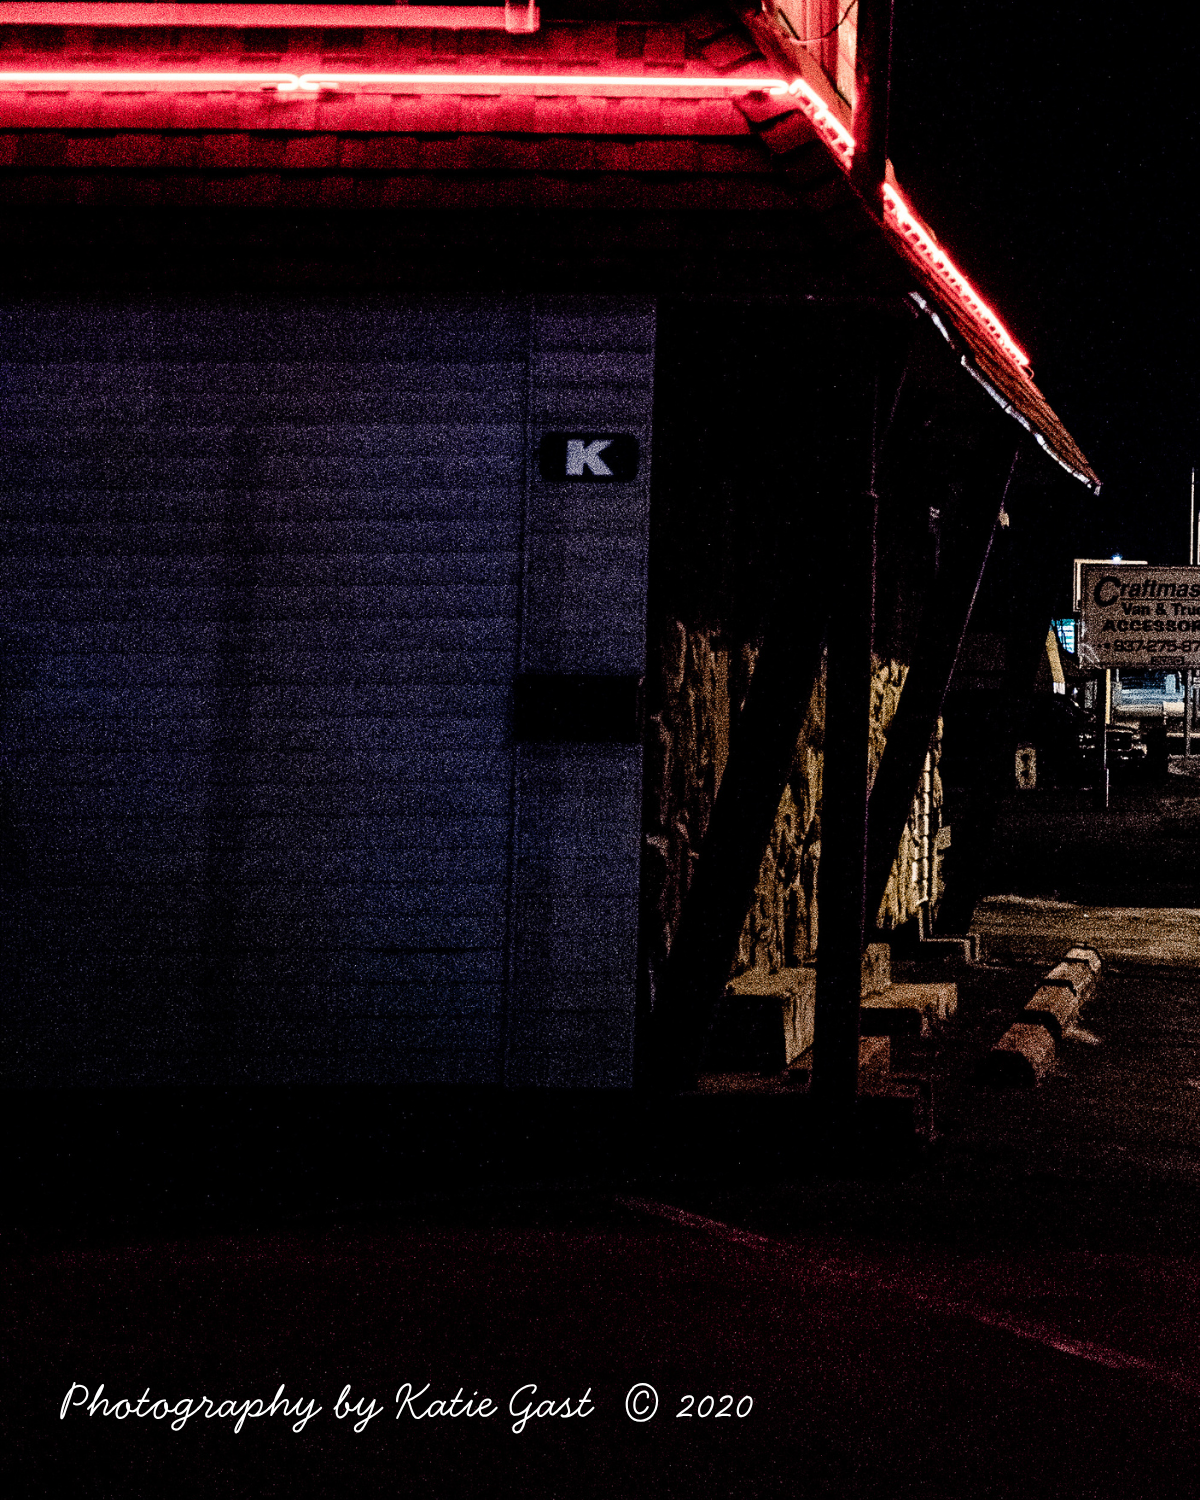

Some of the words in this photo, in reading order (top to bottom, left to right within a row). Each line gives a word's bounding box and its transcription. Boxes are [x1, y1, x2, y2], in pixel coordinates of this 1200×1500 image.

[566, 439, 614, 476] K
[1122, 603, 1149, 616] Van
[1155, 603, 1167, 616] &
